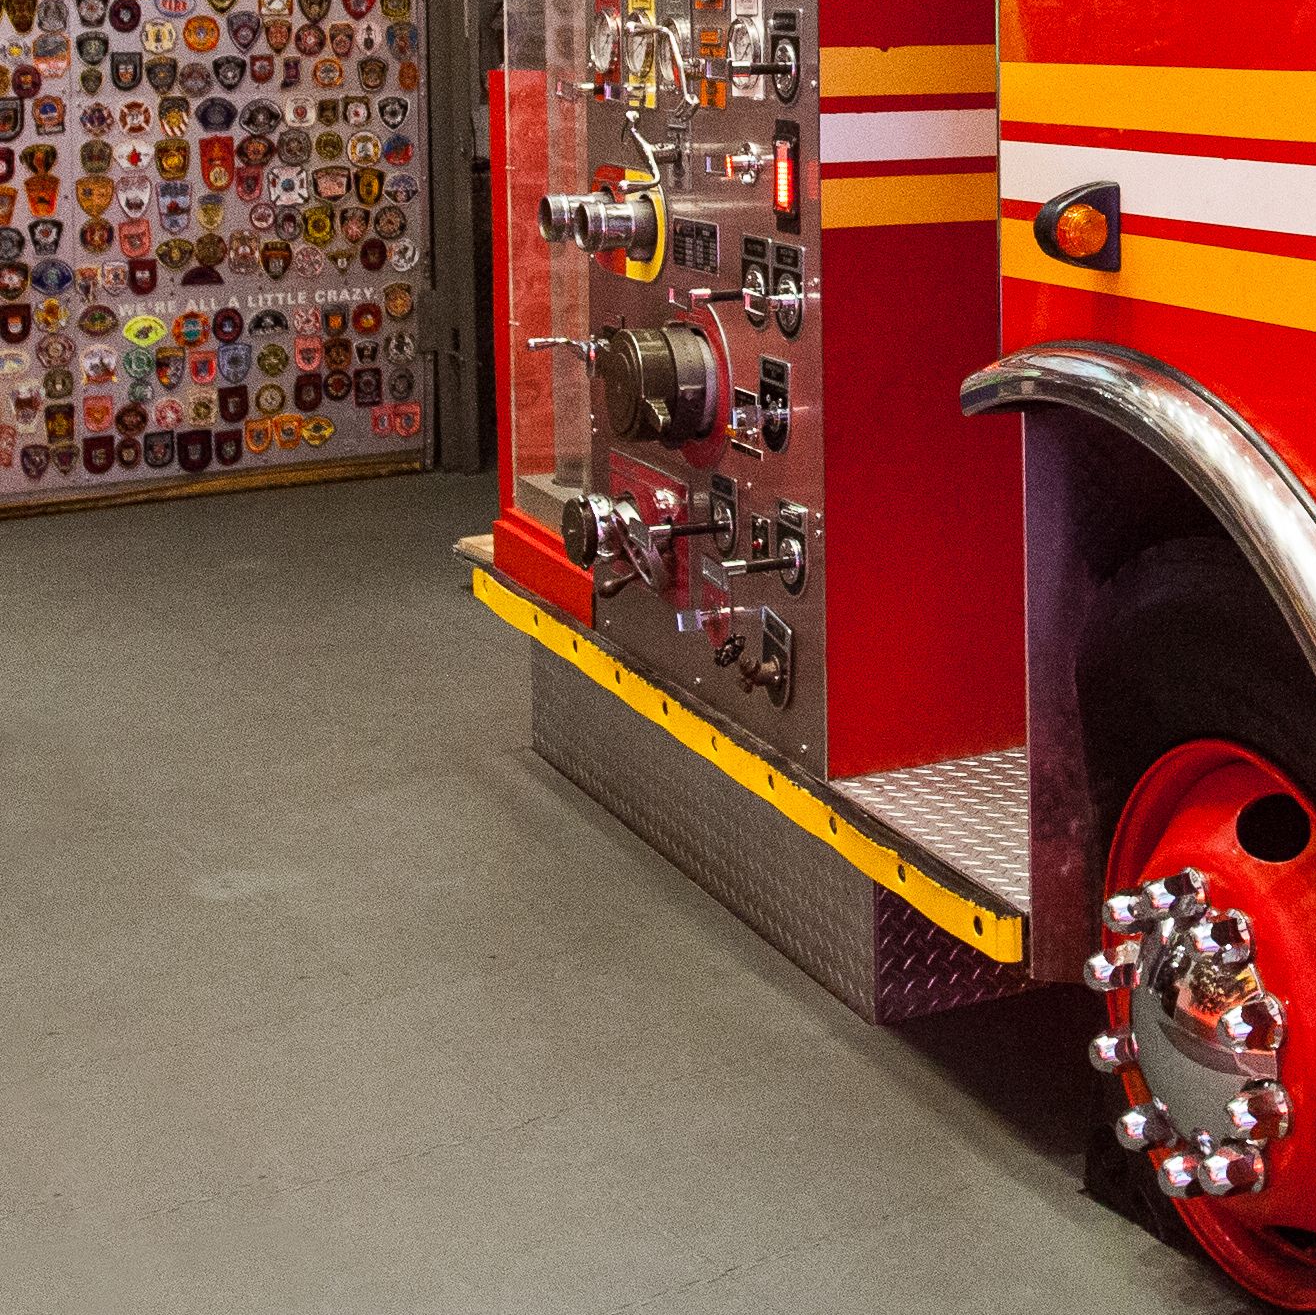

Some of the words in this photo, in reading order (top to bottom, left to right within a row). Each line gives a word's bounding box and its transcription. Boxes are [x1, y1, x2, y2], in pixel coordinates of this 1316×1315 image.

[117, 299, 177, 317] WE'RE
[185, 297, 217, 313] ALL
[227, 295, 241, 308] A
[247, 290, 307, 307] LITTLE
